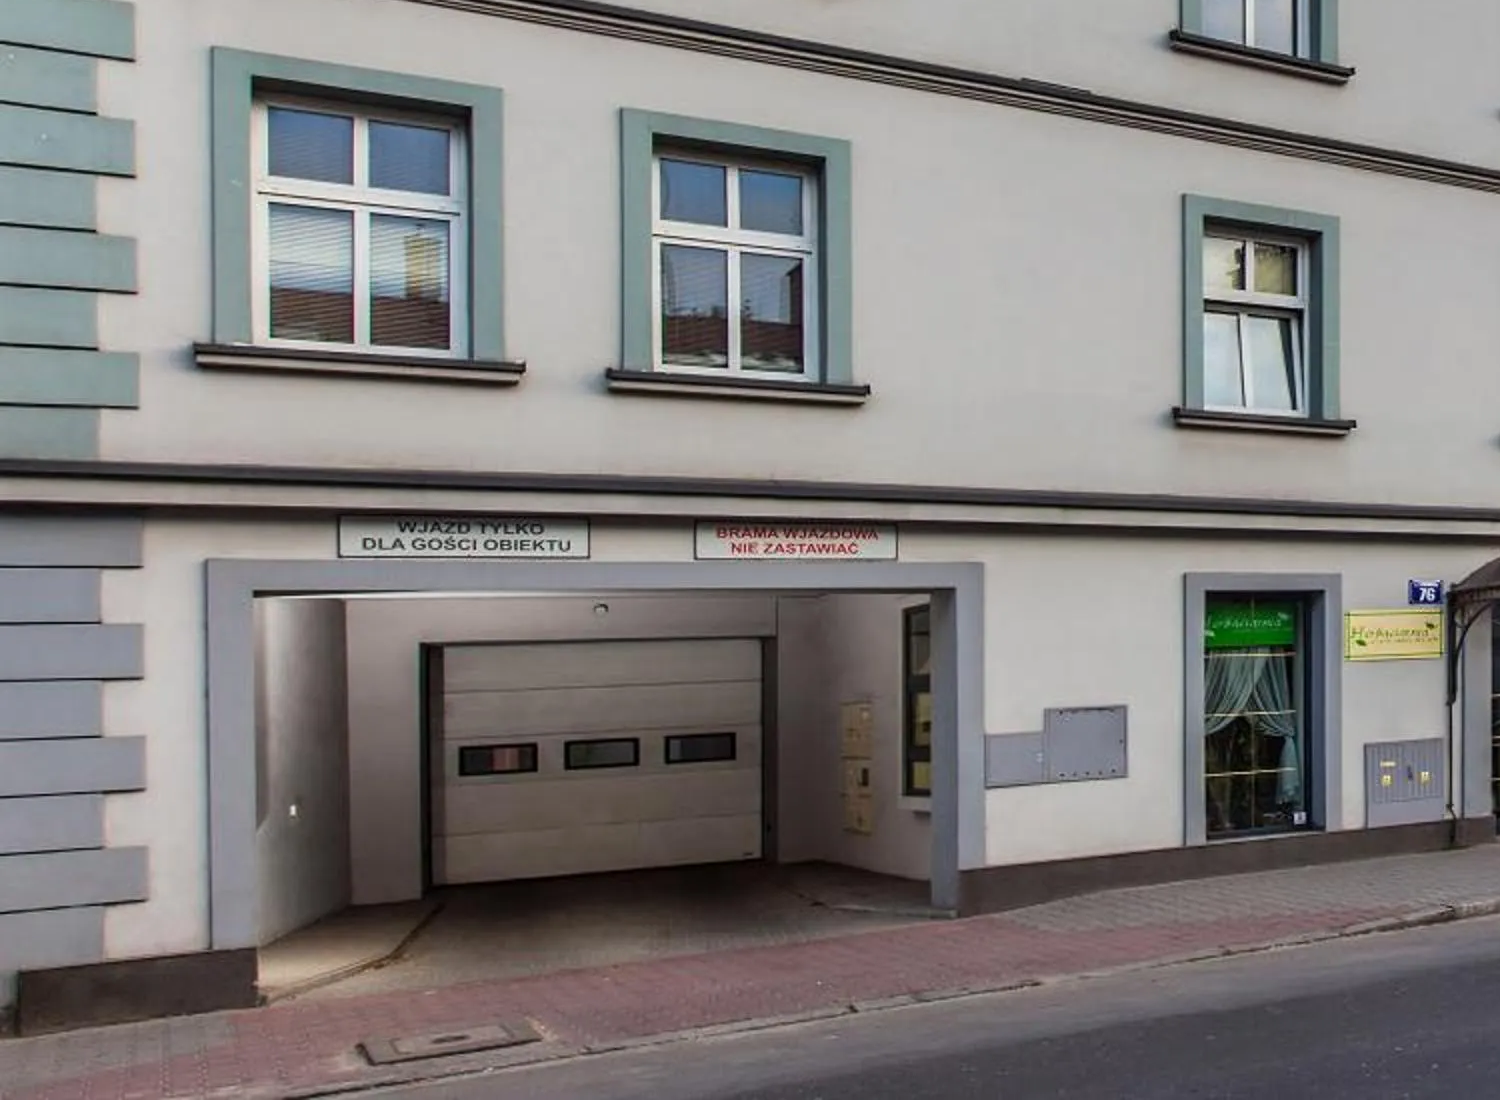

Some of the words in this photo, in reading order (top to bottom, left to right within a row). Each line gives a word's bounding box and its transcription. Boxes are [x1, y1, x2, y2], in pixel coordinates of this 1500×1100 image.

[397, 521, 471, 535] WJAZD
[478, 521, 545, 535] TYLKO
[716, 526, 777, 539] BRAMA
[782, 527, 879, 540] WJAZDOWA
[362, 537, 405, 550] DLA
[411, 535, 477, 551] GOŚCI
[483, 538, 571, 552] OBIEKTU
[731, 543, 758, 554] NIE
[763, 541, 859, 555] ZASTAWIAĆ
[1419, 587, 1436, 601] 76
